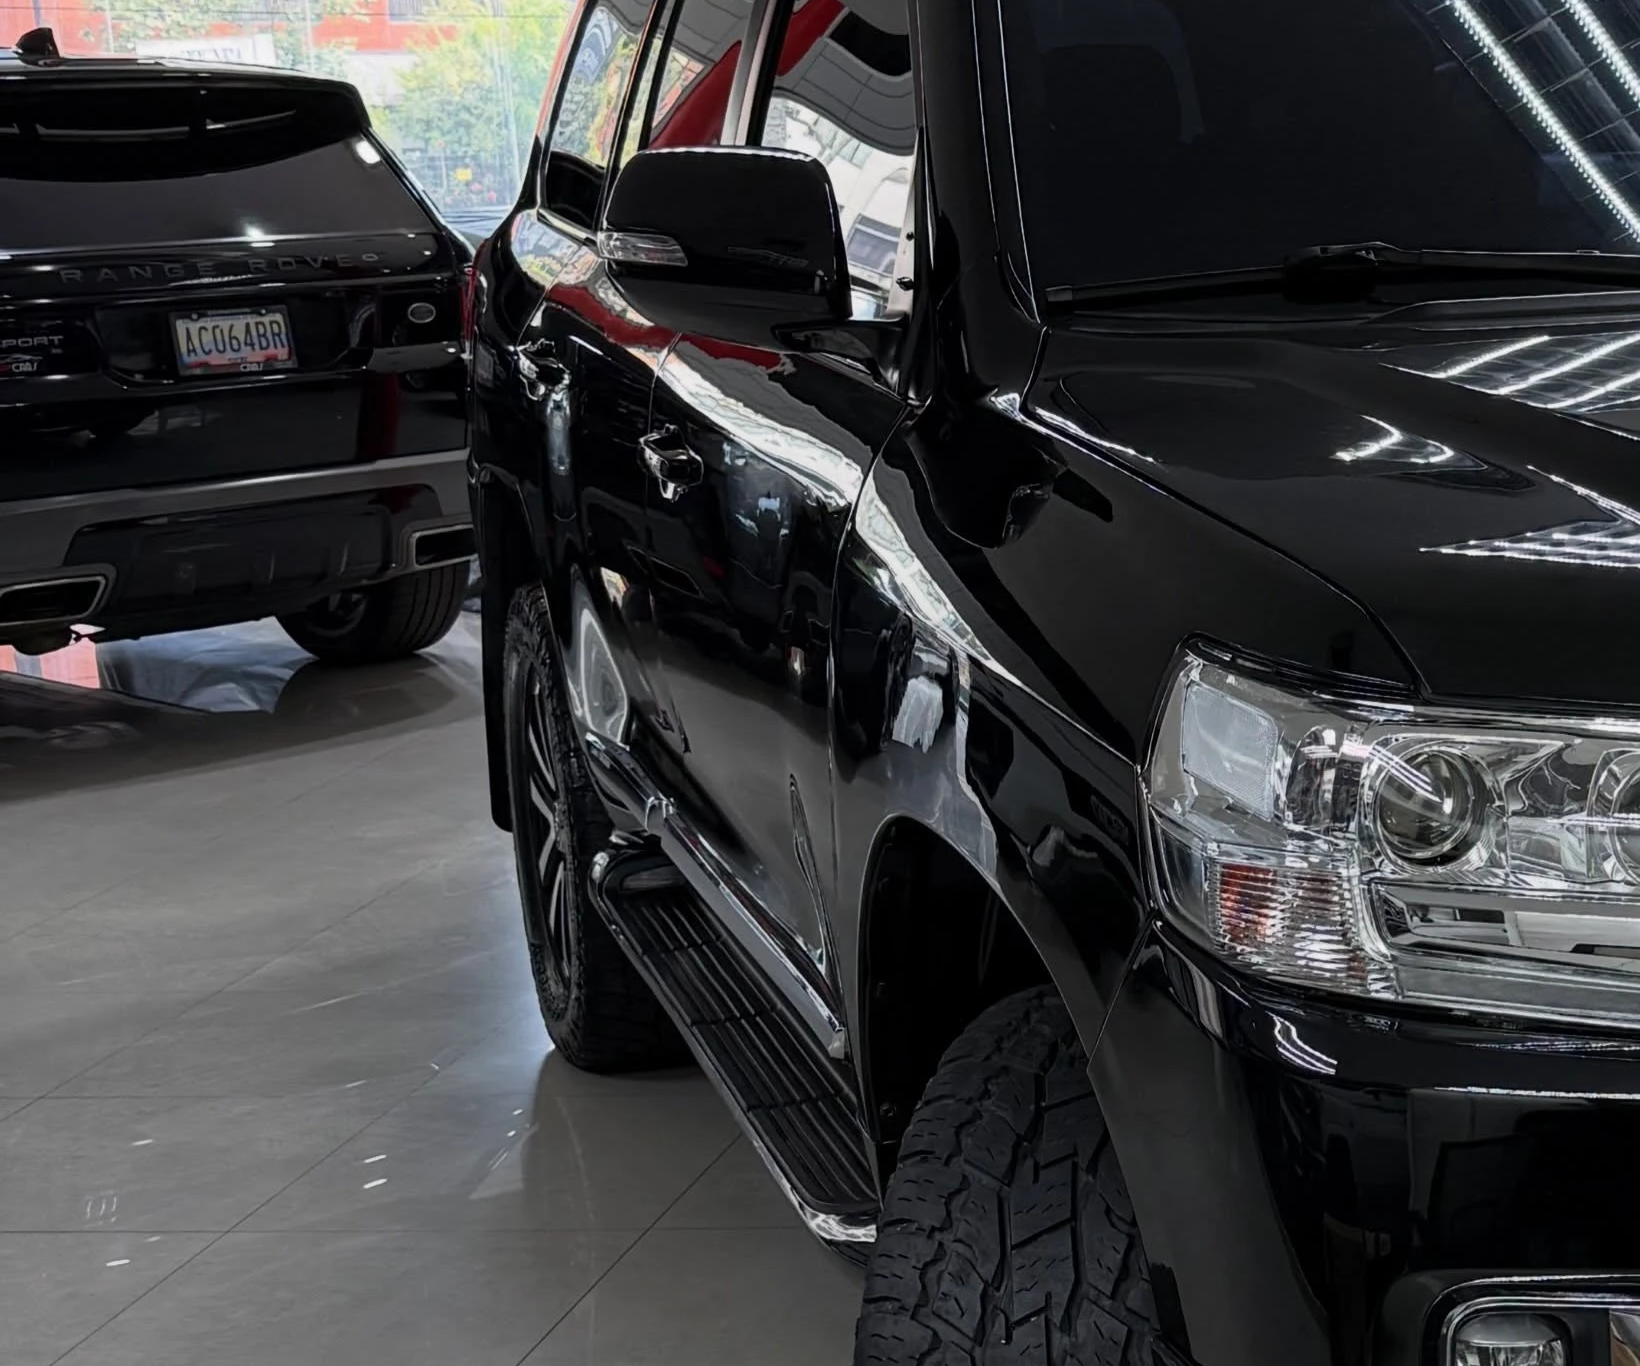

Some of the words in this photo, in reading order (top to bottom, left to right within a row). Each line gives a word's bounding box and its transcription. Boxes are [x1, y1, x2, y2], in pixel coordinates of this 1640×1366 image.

[59, 261, 217, 283] RANGE
[0, 335, 65, 348] PORT
[185, 320, 286, 357] AC064BR
